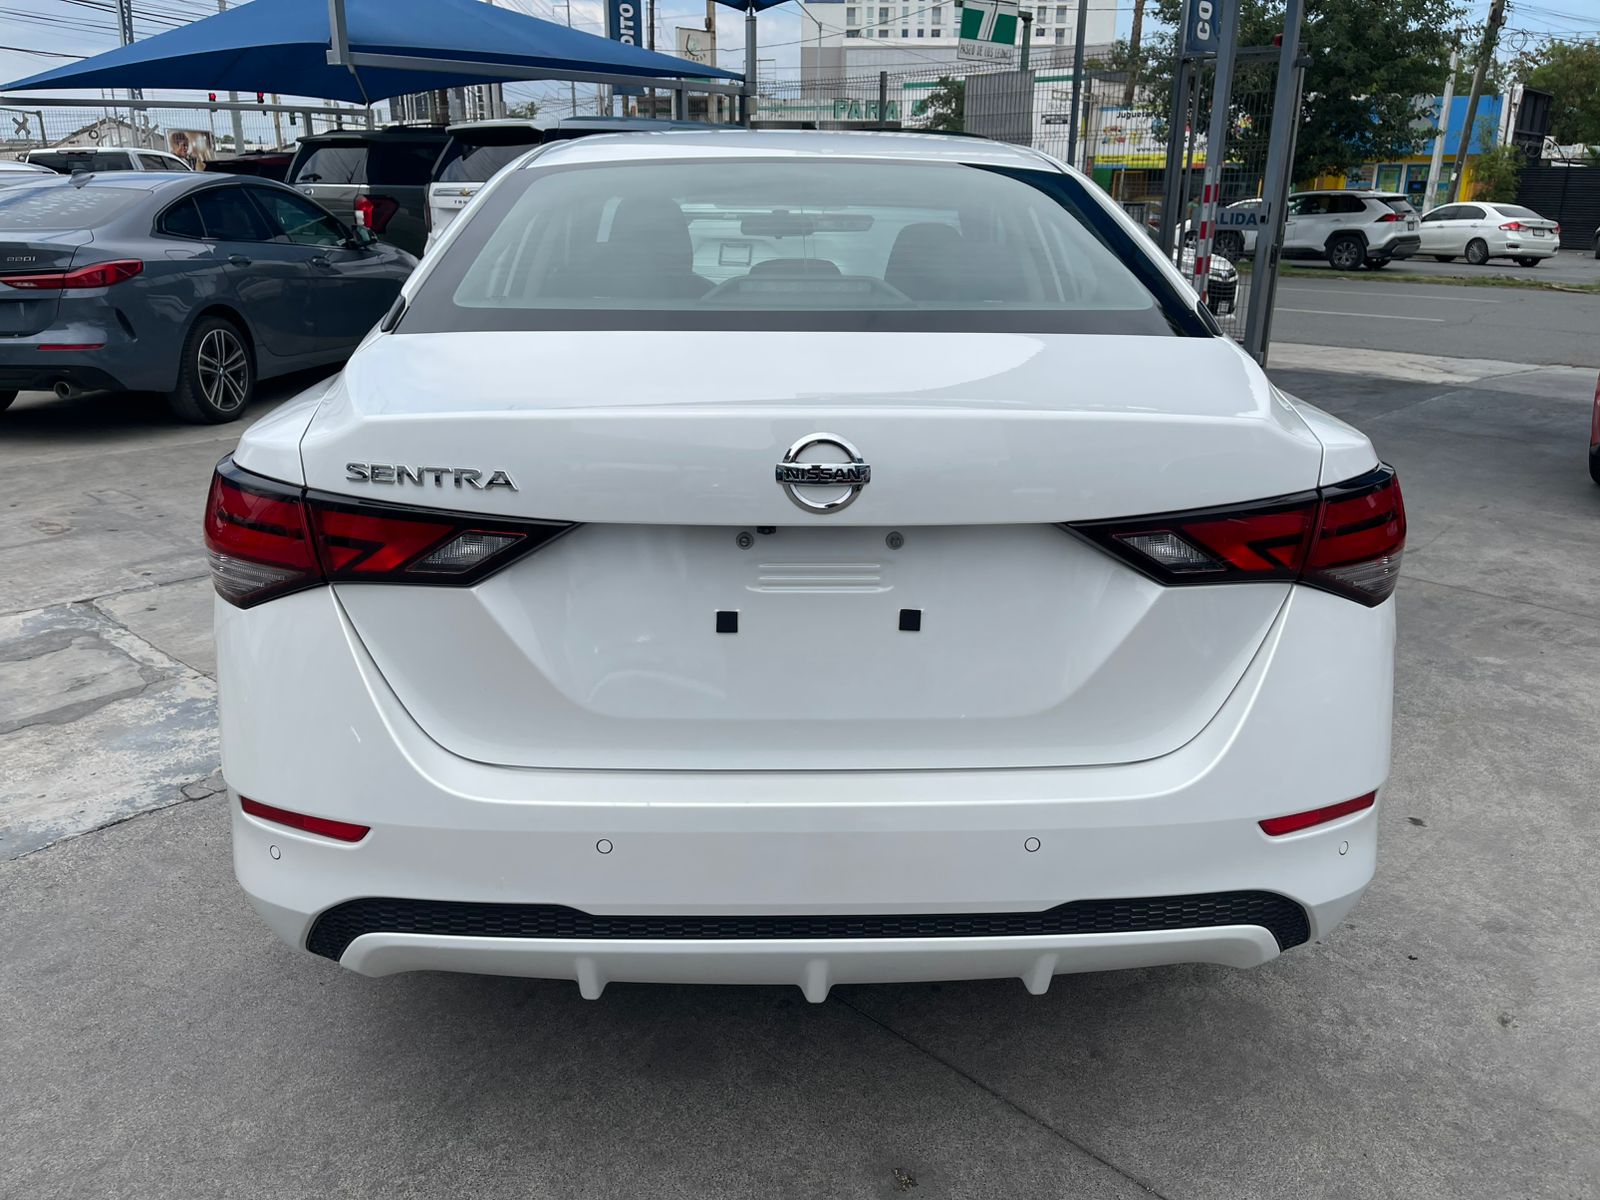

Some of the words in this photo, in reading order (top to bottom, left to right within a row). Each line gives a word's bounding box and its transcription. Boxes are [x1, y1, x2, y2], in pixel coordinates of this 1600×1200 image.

[619, 3, 634, 46] DITO
[345, 462, 519, 492] SENTRA
[784, 466, 861, 481] NISSAN
